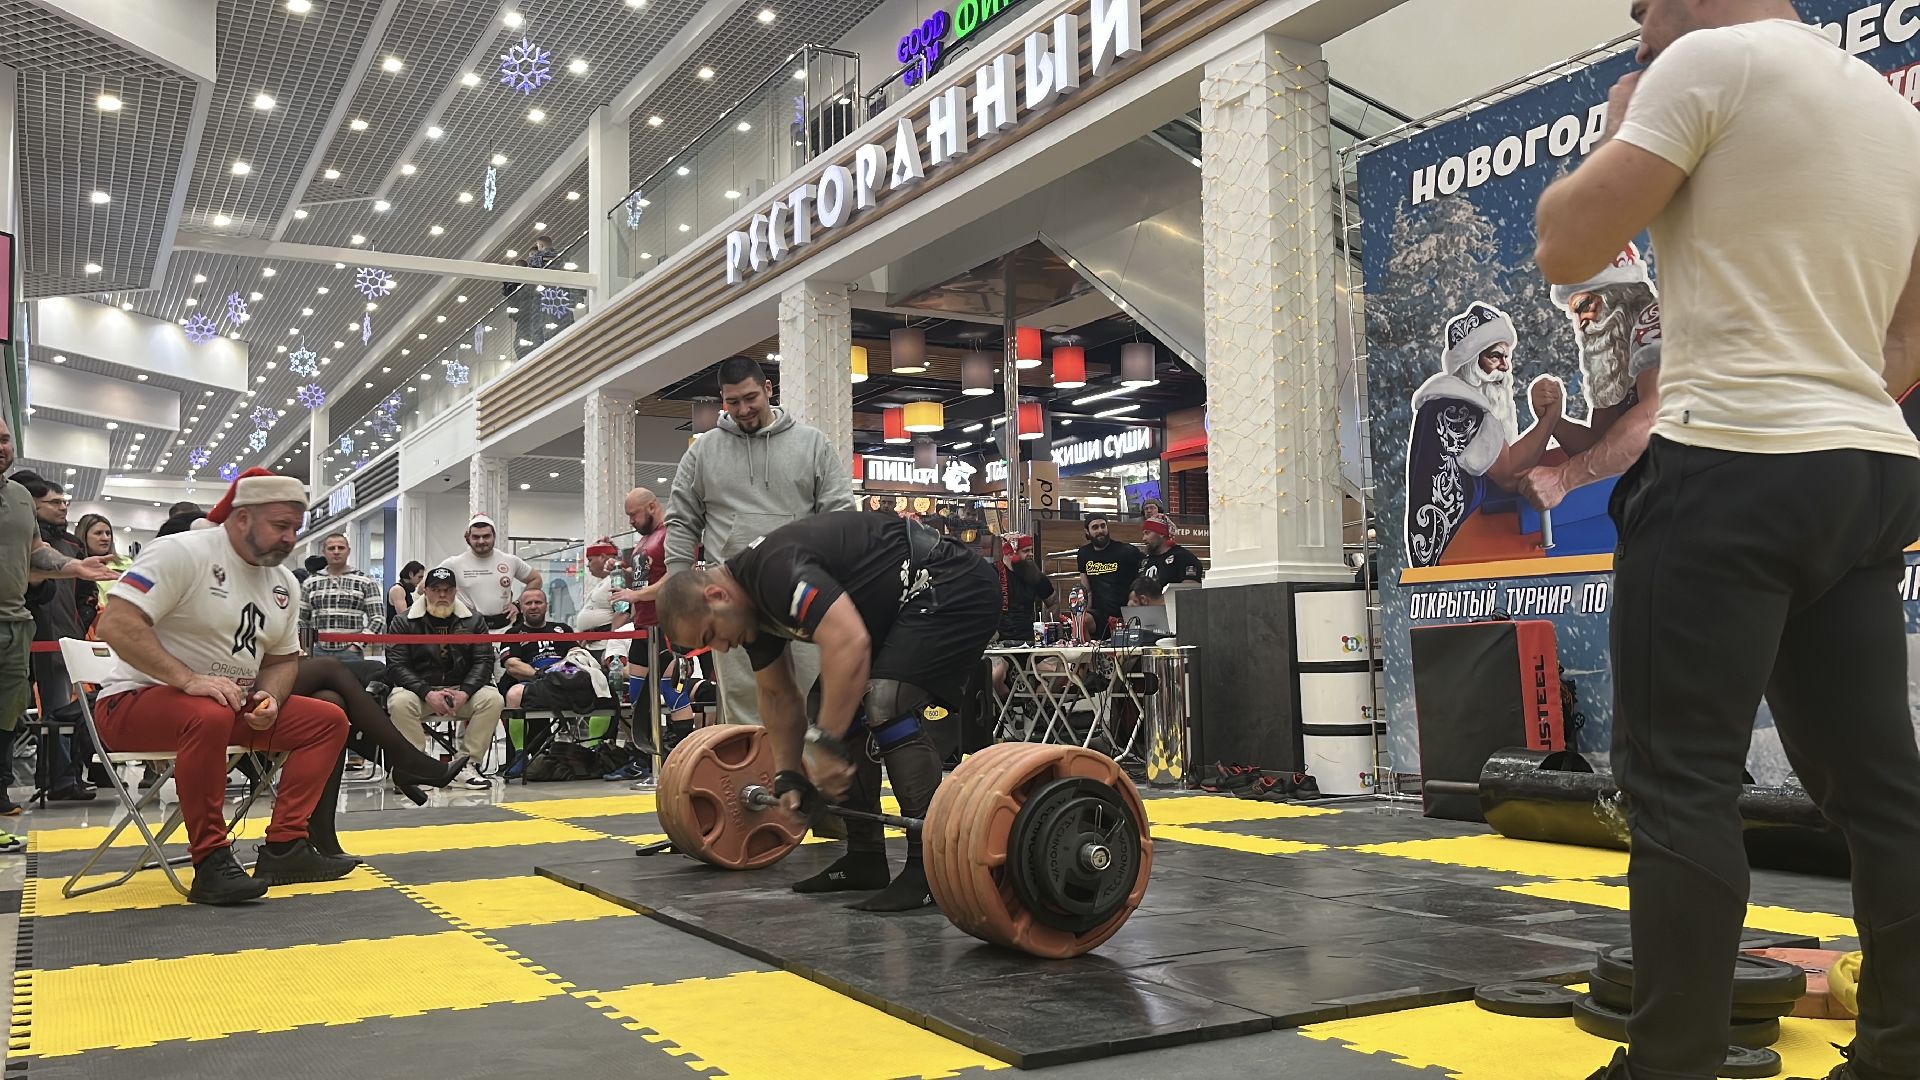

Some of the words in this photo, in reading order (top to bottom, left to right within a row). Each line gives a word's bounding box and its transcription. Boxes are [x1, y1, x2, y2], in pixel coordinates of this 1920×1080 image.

[897, 9, 947, 63] GOOD
[955, 0, 1009, 38] ФИ
[1412, 101, 1609, 206] НОВОГОД
[1103, 427, 1151, 459] СУШИ
[1177, 528, 1191, 536] ГЕР
[1192, 529, 1209, 537] КИН
[1409, 582, 1497, 619] ОТКРЫТЫЙ
[1506, 585, 1572, 616] ТУРНИР
[1581, 583, 1609, 614] ПО
